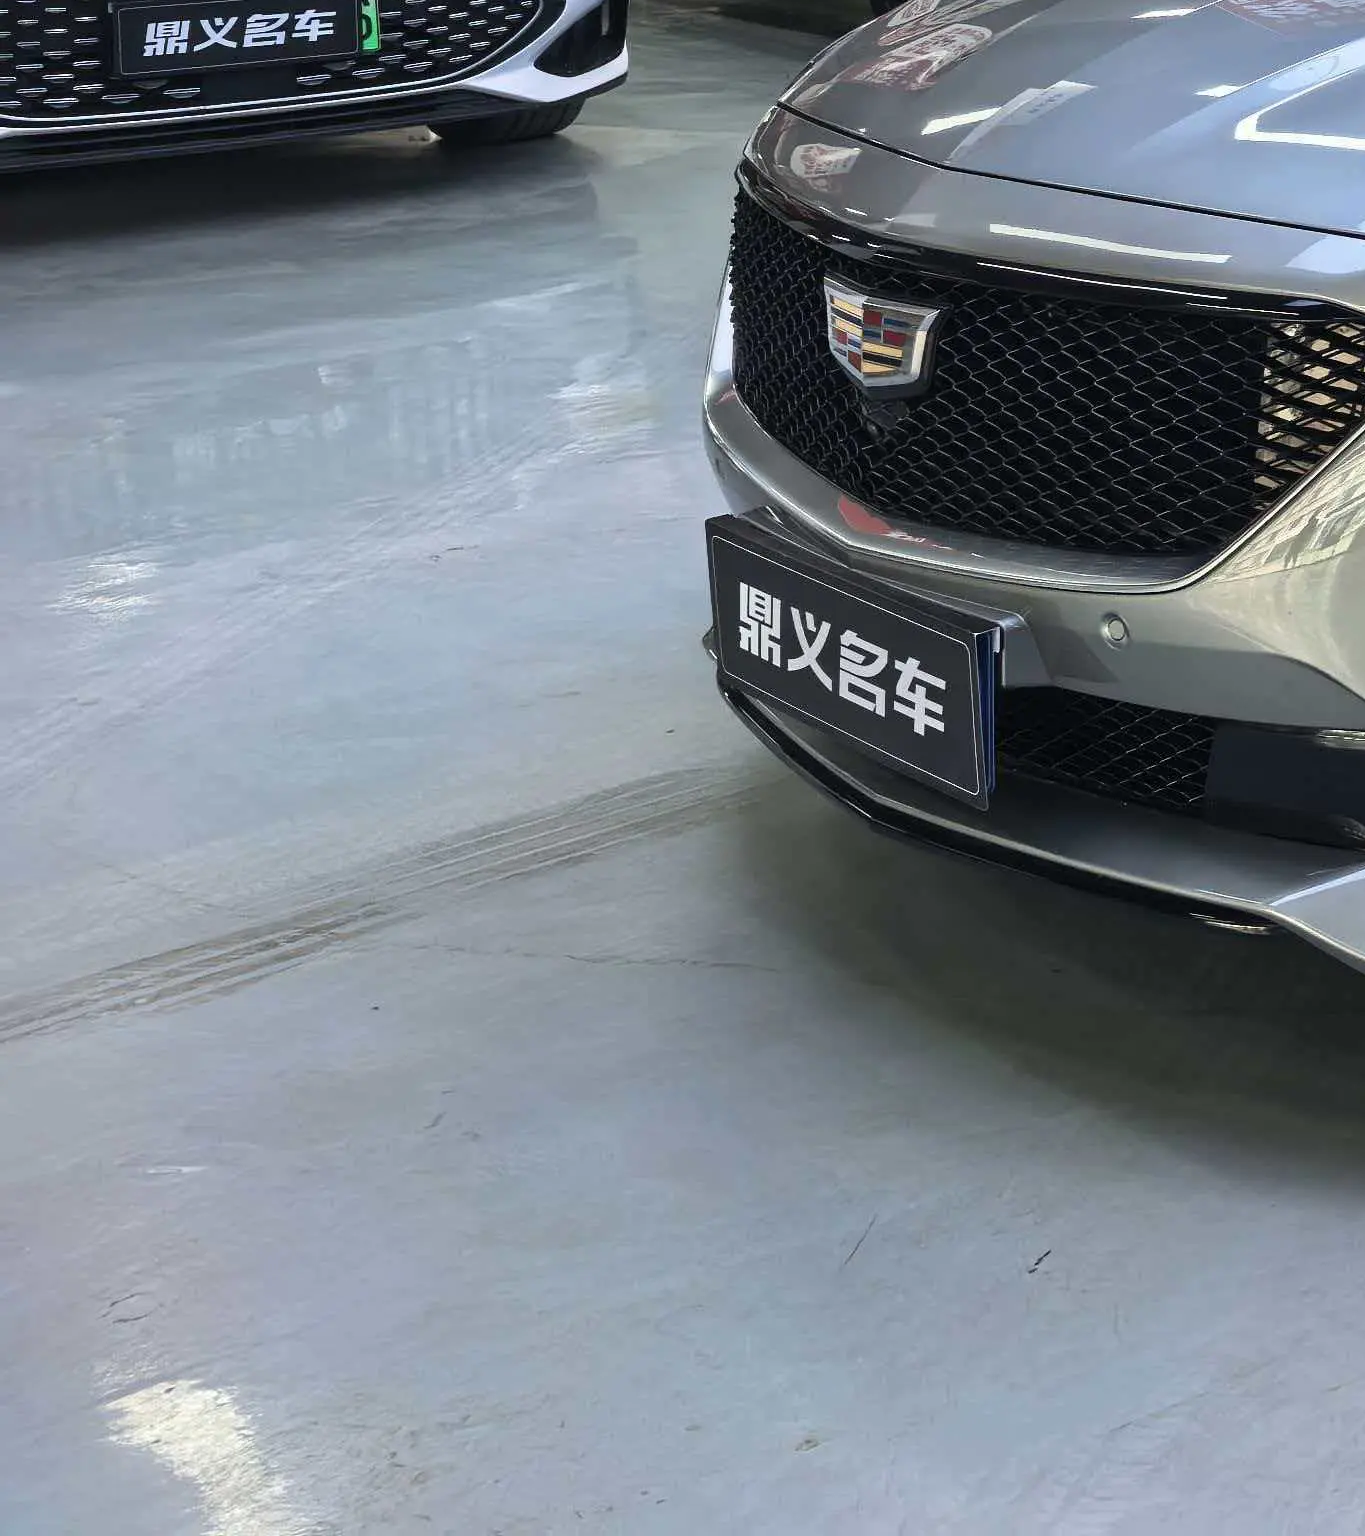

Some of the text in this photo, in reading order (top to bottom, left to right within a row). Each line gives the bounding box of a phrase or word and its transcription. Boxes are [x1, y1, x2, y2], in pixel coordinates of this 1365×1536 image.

[143, 9, 337, 57] 鼎义名车
[738, 582, 946, 736] 鼎义名车
